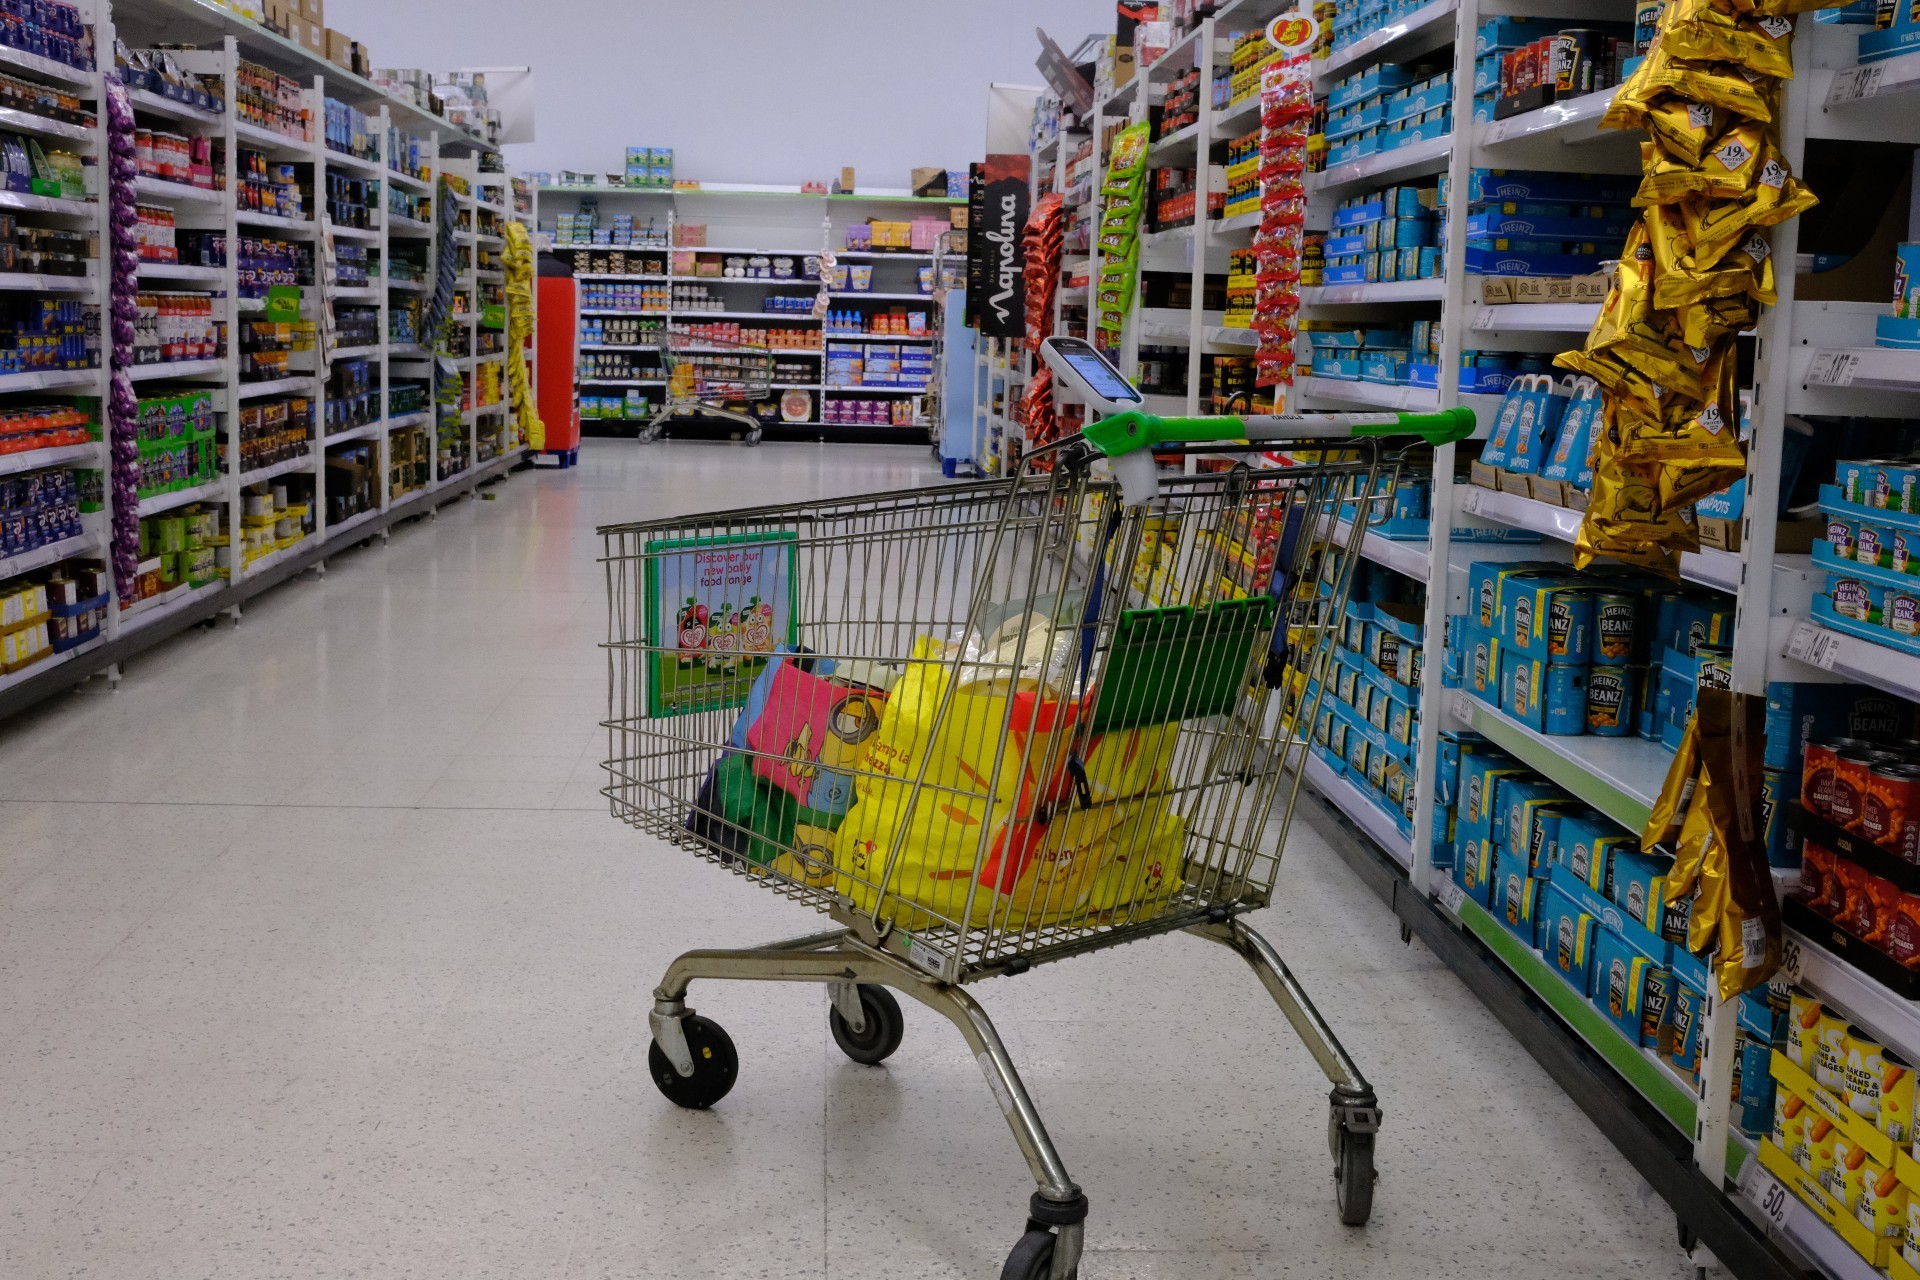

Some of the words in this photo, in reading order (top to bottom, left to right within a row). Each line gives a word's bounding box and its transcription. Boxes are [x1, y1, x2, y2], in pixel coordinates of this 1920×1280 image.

[1287, 21, 1302, 32] Jelly
[1280, 31, 1299, 42] Belly
[1499, 186, 1527, 198] HEINZ
[1503, 222, 1531, 235] HEINZ
[985, 194, 1023, 324] Napolina
[1499, 261, 1527, 273] HEINZ
[1475, 528, 1505, 540] HEINZ
[1829, 526, 1847, 536] HEINZ
[695, 552, 740, 564] Discover
[744, 551, 760, 561] our
[704, 567, 724, 576] new
[728, 563, 752, 575] baby
[701, 576, 722, 587] food
[727, 574, 752, 586] ange
[1838, 583, 1858, 593] HEIN
[1837, 592, 1858, 602] BEAN
[1606, 606, 1632, 616] HEINZ
[1895, 599, 1915, 611] HEINZ
[1894, 608, 1915, 620] BEANZ
[1602, 620, 1633, 632] BEANZ
[1592, 676, 1618, 688] HEINZ
[1590, 689, 1622, 702] BEANZ
[1859, 703, 1891, 713] HEINZ
[1853, 717, 1894, 733] BEANZ
[898, 750, 910, 764] la
[1837, 838, 1852, 853] ASDA
[1666, 914, 1688, 929] ANZ
[1832, 931, 1847, 948] ASDA
[1846, 1065, 1871, 1080] BAKED
[1846, 1074, 1870, 1088] BEANS
[1871, 1080, 1879, 1090] &
[1845, 1082, 1879, 1099] SAUSAGE
[1814, 1091, 1836, 1114] ESSENTIALS
[1838, 1112, 1849, 1126] ASDA
[1763, 1183, 1785, 1223] 50p
[1802, 1181, 1823, 1206] ESSENTIALS
[1826, 1204, 1836, 1217] ASDA
